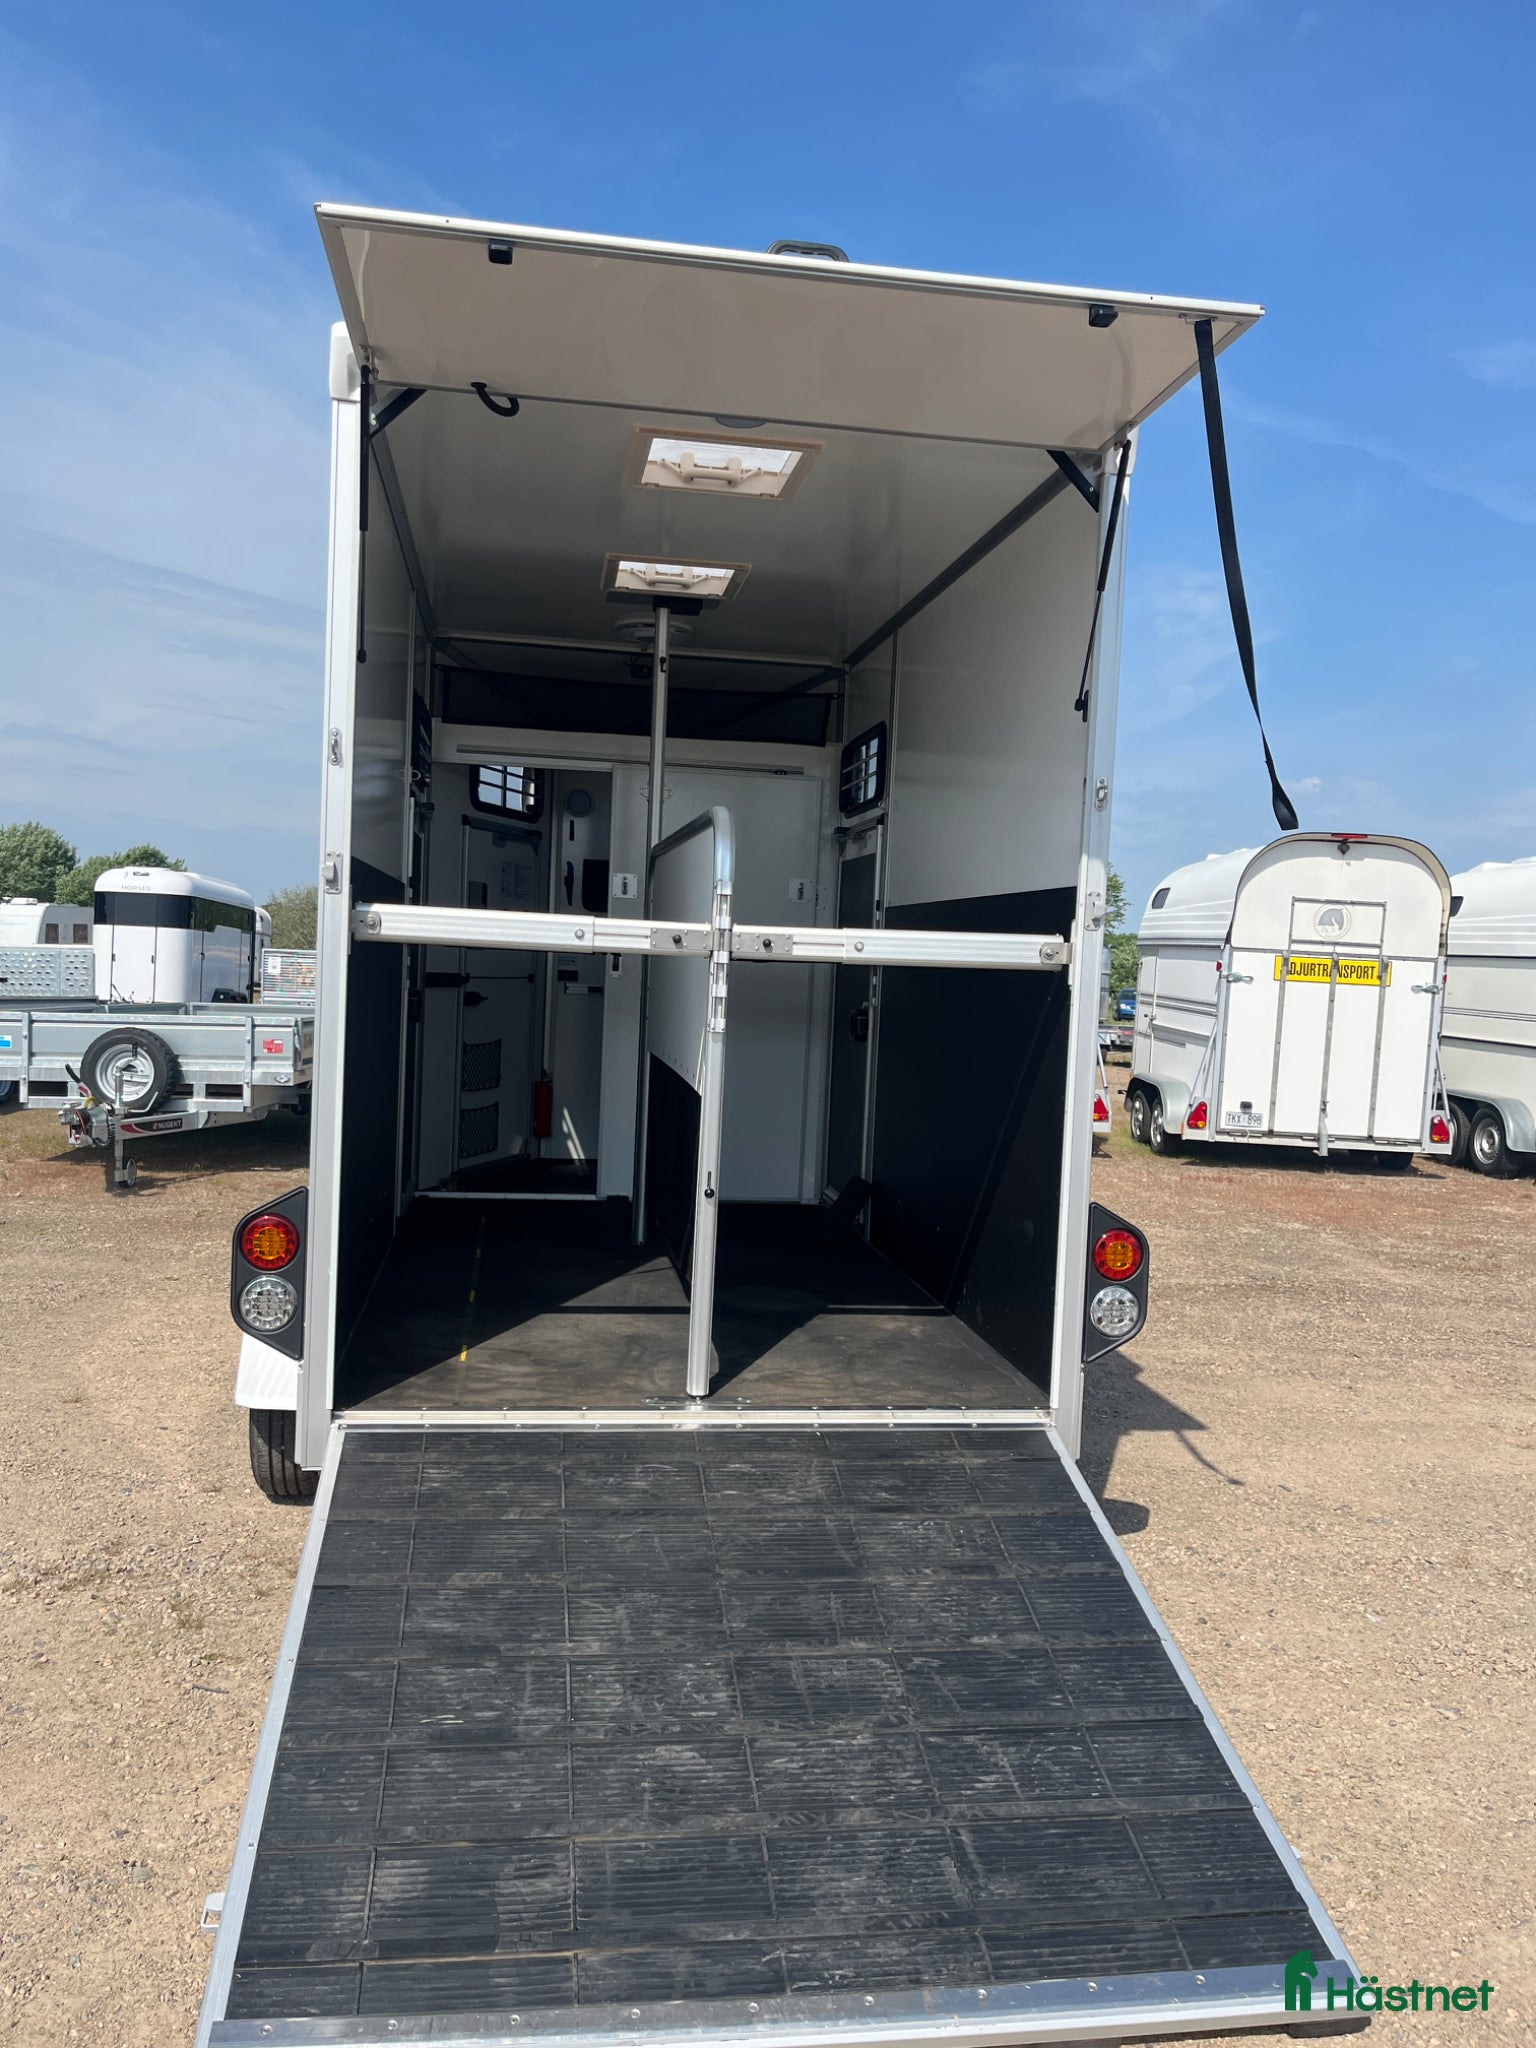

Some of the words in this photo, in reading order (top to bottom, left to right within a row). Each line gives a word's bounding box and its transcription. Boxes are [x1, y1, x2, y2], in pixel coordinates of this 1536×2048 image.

[1290, 961, 1376, 979] DJURTRNSPORT
[158, 1120, 182, 1129] NUGENT
[1227, 1113, 1242, 1125] TKX
